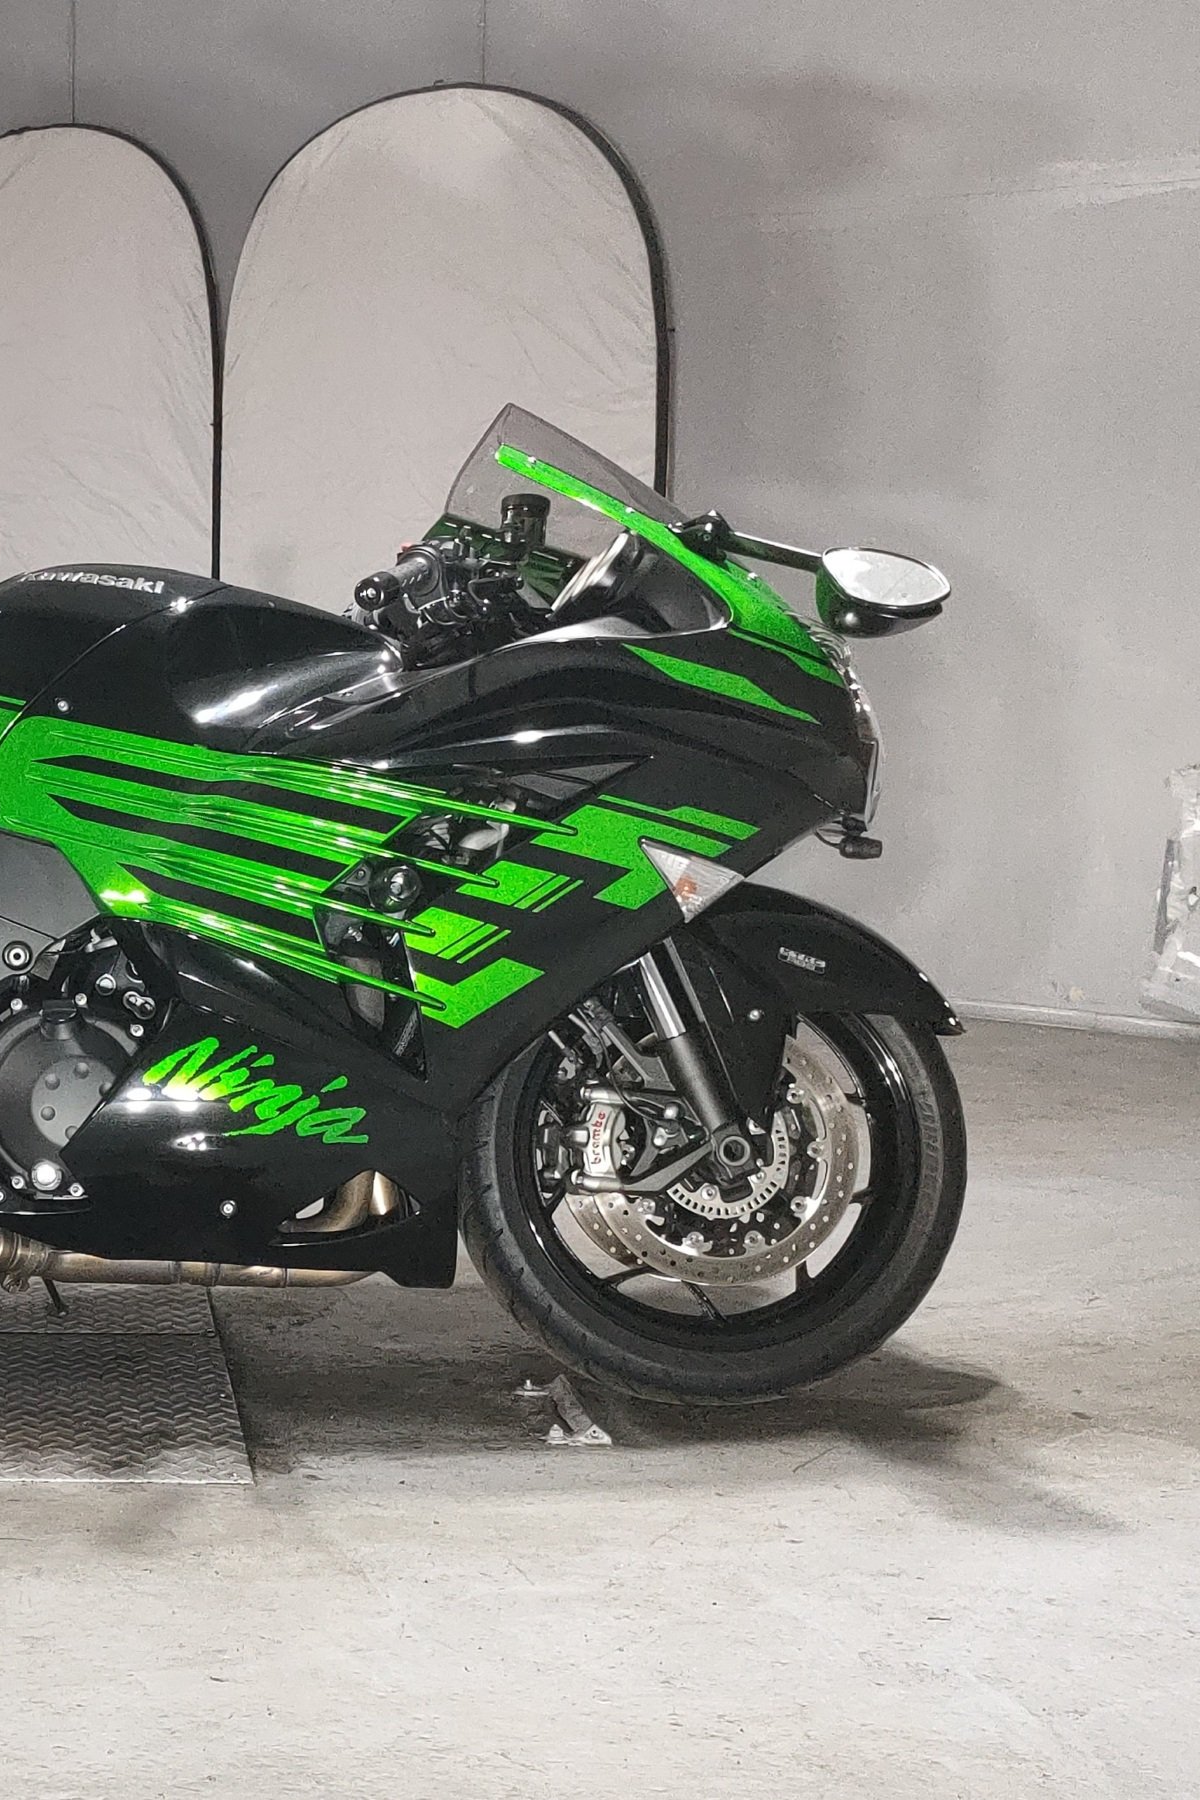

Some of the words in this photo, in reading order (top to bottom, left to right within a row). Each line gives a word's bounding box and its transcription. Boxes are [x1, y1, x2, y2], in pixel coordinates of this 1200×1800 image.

[19, 571, 165, 595] Kawasaki
[142, 1036, 370, 1145] Ninja
[591, 1112, 606, 1165] brembo
